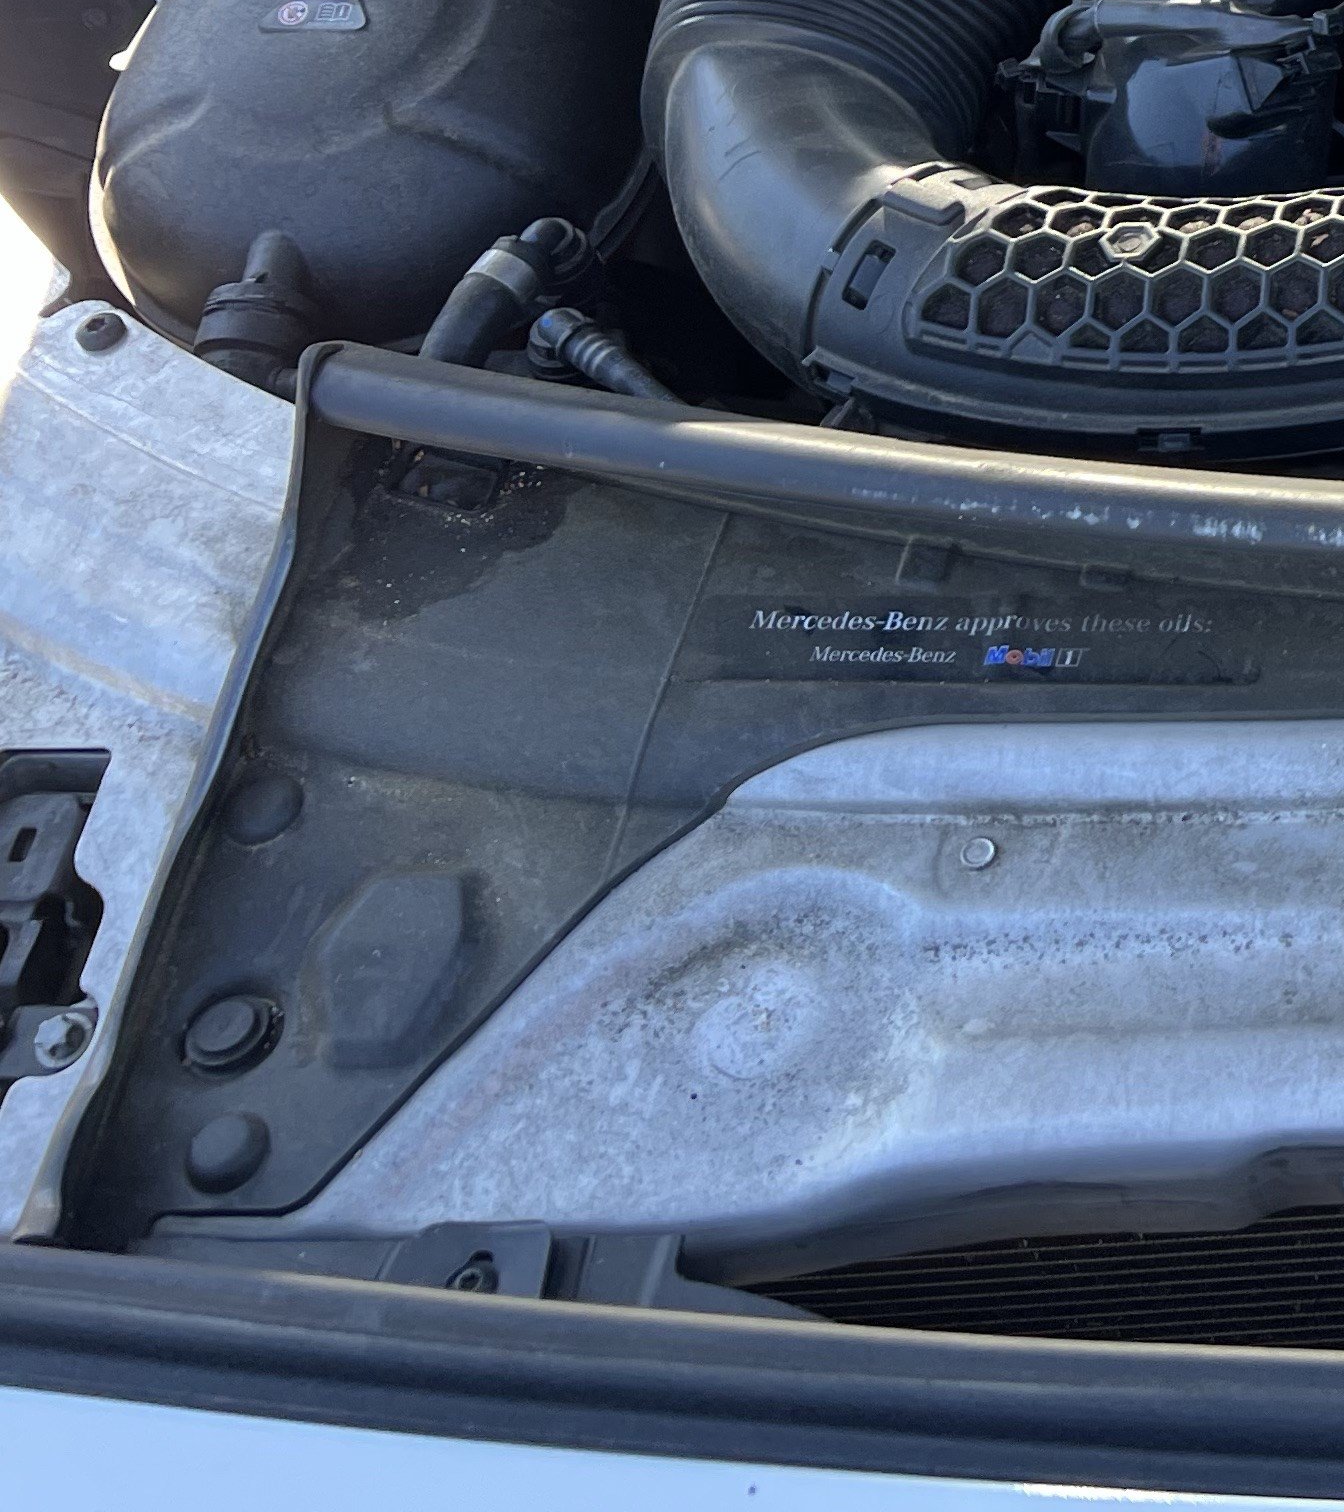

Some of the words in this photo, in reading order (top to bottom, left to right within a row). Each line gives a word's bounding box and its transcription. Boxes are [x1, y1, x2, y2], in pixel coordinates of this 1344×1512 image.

[749, 610, 949, 631] Mercedes-Benz
[955, 615, 1072, 636] approves
[1081, 614, 1150, 632] these
[1158, 613, 1212, 633] oils:
[809, 646, 956, 663] Mercedes-Benz
[984, 645, 1056, 667] Mobil
